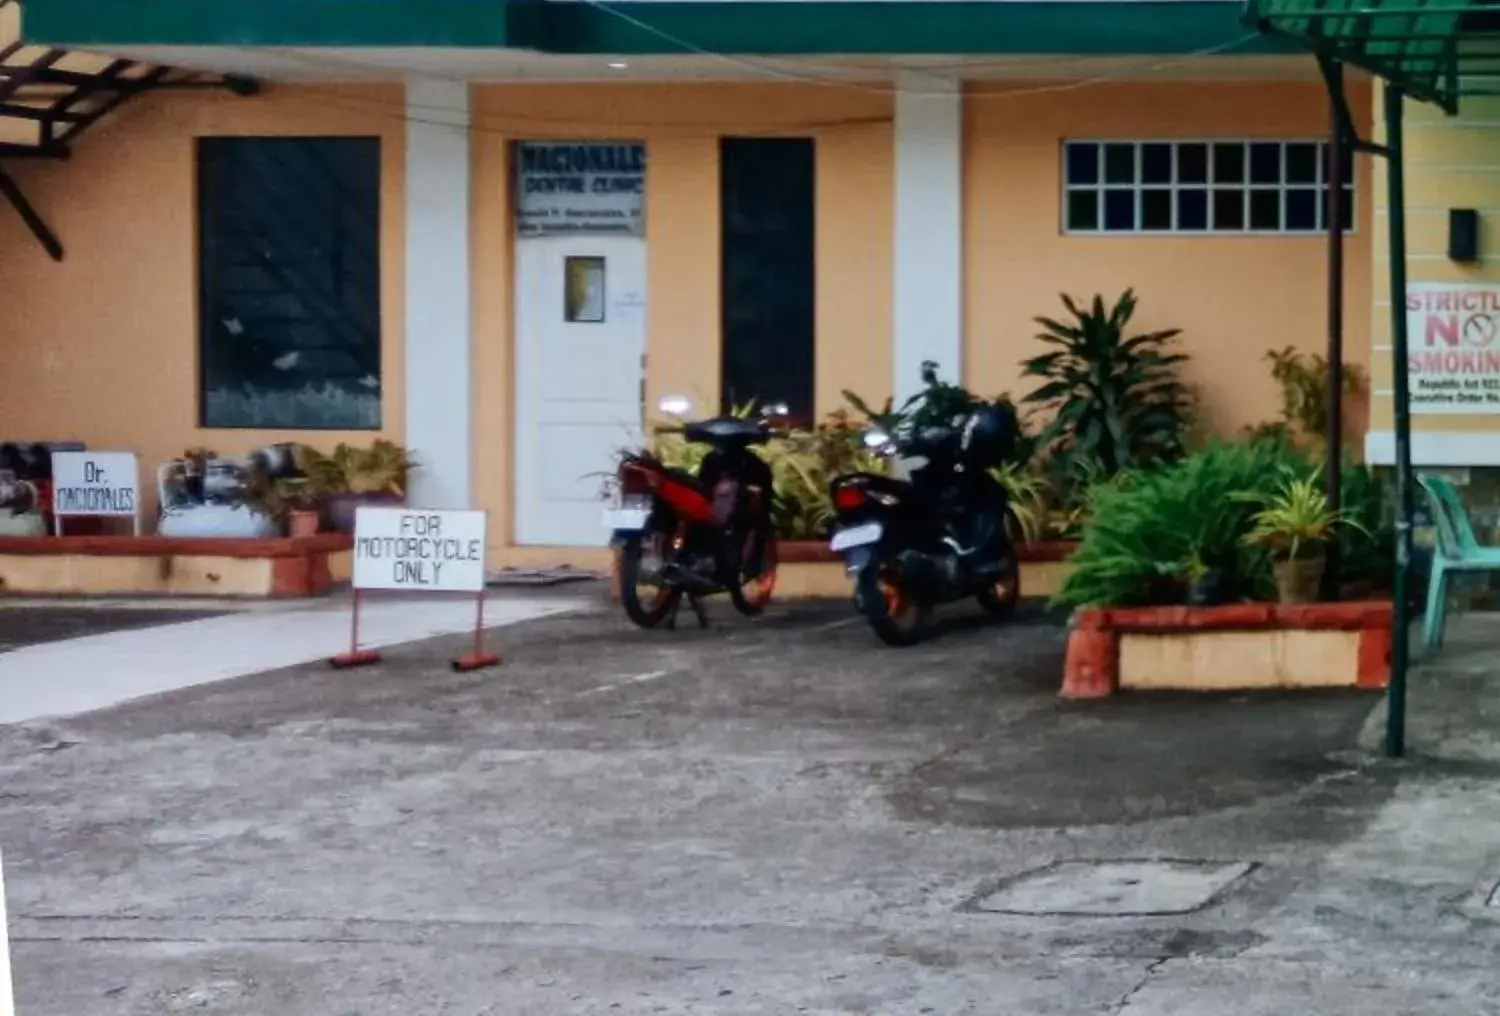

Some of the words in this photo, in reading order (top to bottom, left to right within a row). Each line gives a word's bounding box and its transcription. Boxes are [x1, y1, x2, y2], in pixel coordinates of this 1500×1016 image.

[400, 515, 441, 535] FOR
[357, 537, 481, 561] MOTORCYCLE
[393, 561, 443, 584] ONLY
